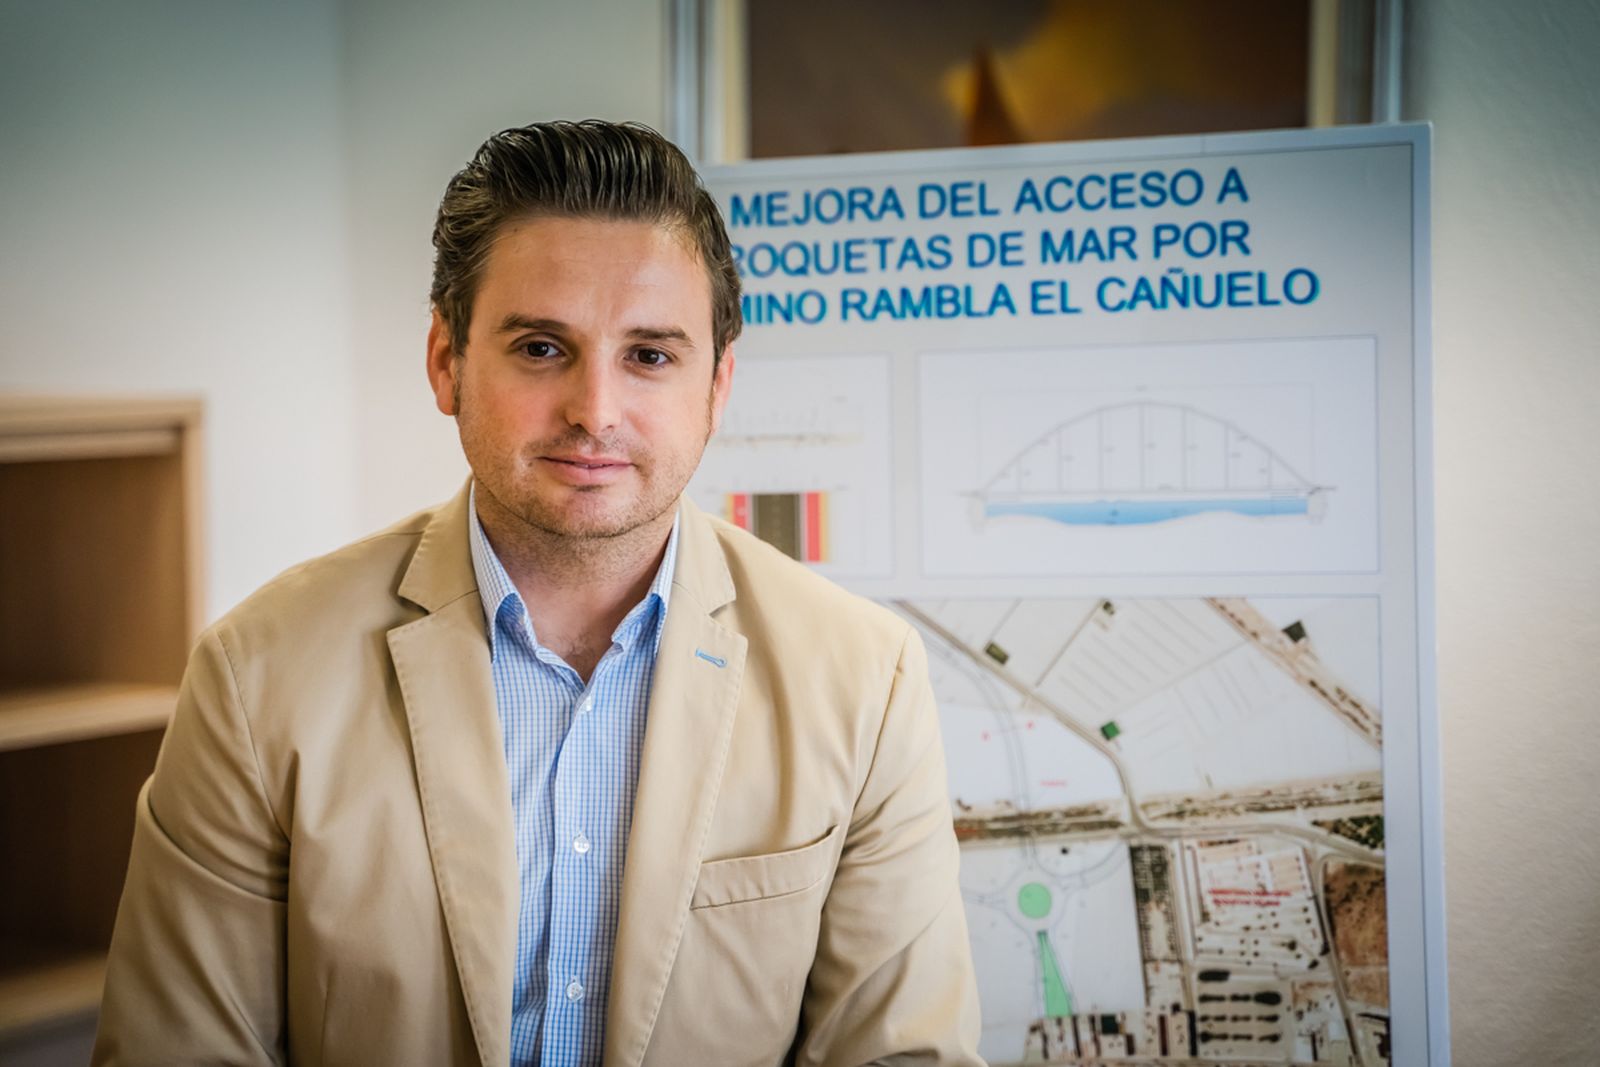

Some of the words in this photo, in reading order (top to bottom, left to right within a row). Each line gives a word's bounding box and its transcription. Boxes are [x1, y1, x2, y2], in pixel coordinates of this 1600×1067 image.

[731, 187, 904, 228] MEJORA
[918, 182, 1000, 219] DEL
[1014, 169, 1204, 214] ACCESO
[1217, 167, 1249, 203] A
[968, 231, 1024, 268] DE
[1041, 226, 1138, 264] MAR
[1153, 220, 1251, 259] POR
[841, 283, 1017, 320] RAMBLA
[1030, 279, 1083, 315] EL
[1096, 267, 1320, 312] CAÑUELO
